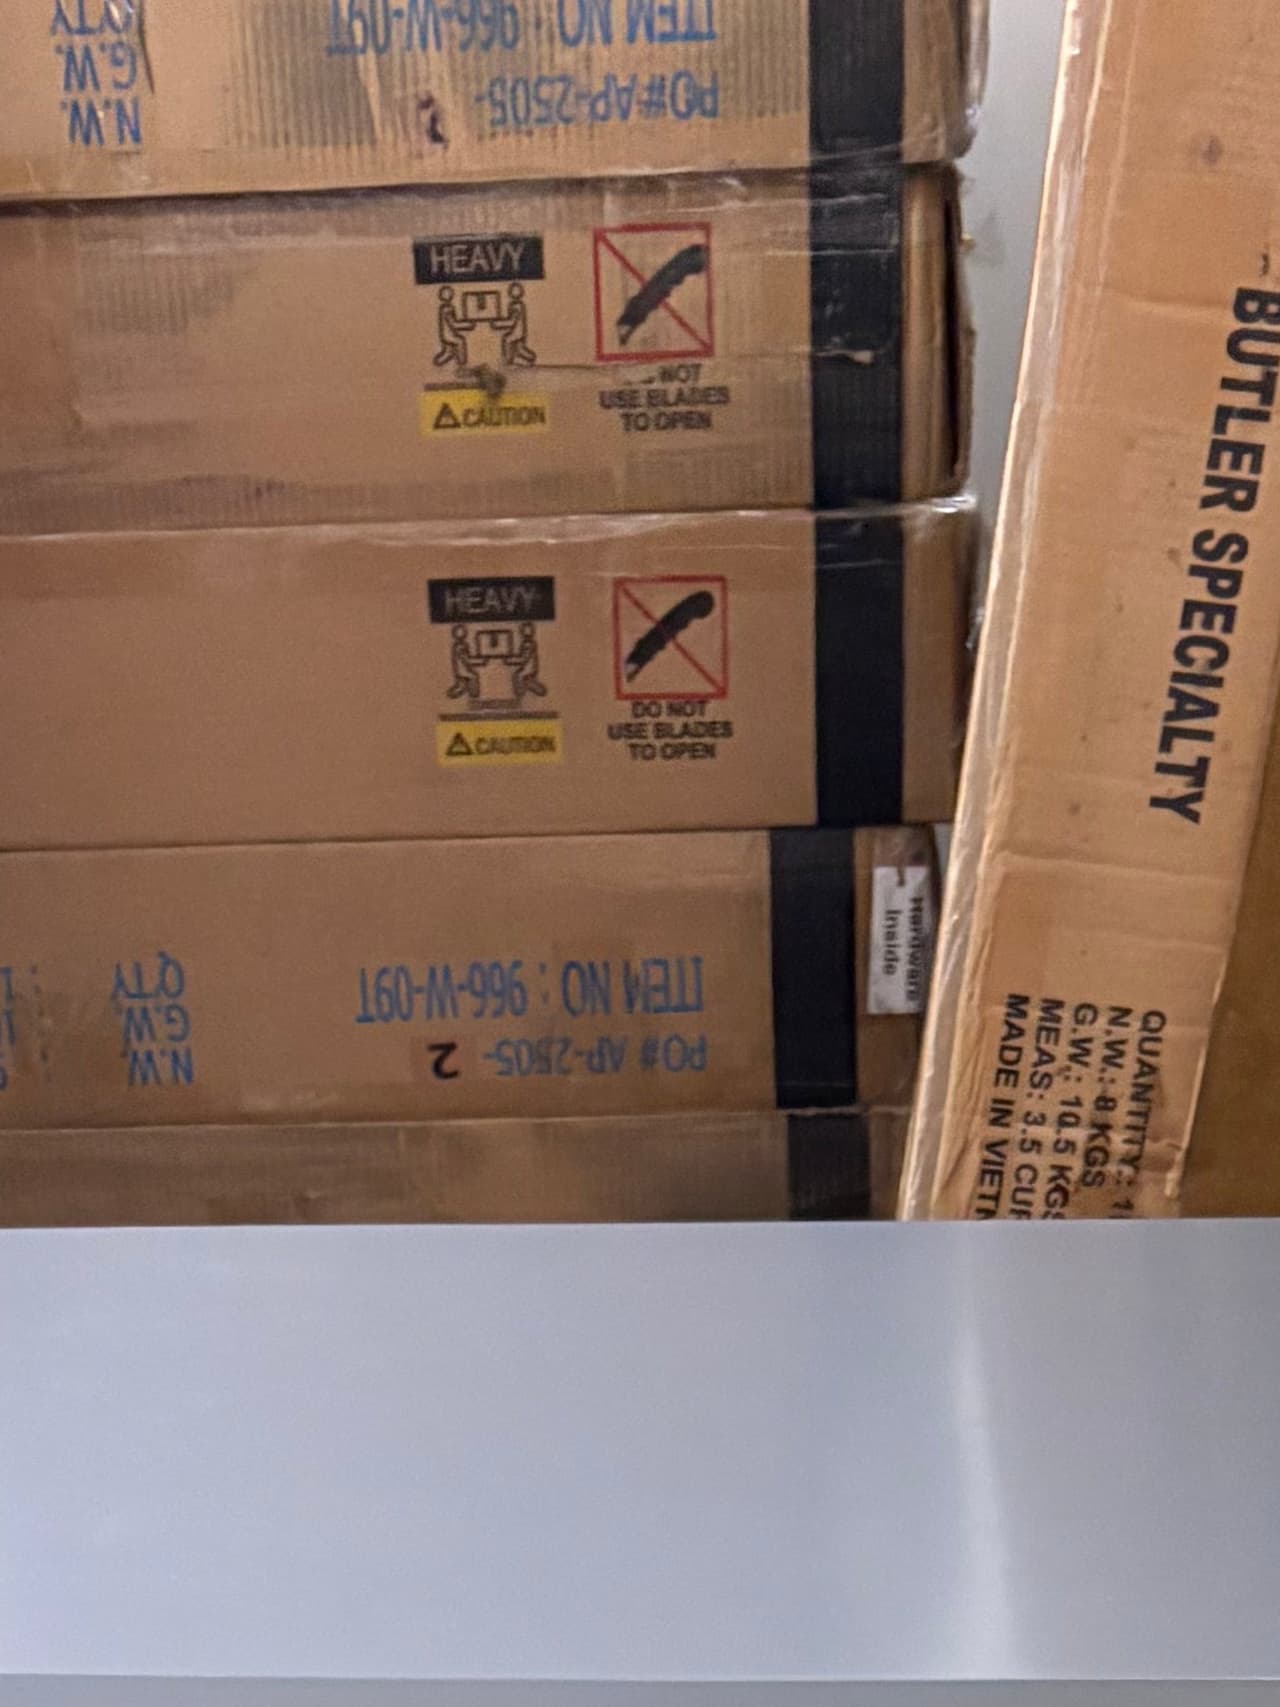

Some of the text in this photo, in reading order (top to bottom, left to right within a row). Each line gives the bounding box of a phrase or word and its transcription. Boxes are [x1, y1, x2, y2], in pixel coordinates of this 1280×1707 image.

[61, 100, 142, 147] N.W.
[430, 242, 524, 274] HEAVY
[462, 406, 547, 427] CAUTION
[622, 410, 712, 431] TO OPEN
[445, 586, 538, 614] HEAVY
[1149, 528, 1250, 826] SPECIALTY
[607, 721, 734, 741] USE BLADES
[632, 701, 707, 718] DO NOT
[629, 741, 716, 760] TO OPEN
[883, 909, 903, 975] Inside
[355, 959, 528, 1023] 966-W-09T
[561, 960, 612, 1013] NO
[624, 956, 705, 1014] ITEM
[427, 1042, 462, 1080] 2
[993, 992, 1030, 1089] MADE
[1025, 998, 1066, 1100] MEAS:
[988, 1097, 1014, 1128] IN
[1019, 1111, 1047, 1155] 3.5
[1081, 1122, 1114, 1188] KGS
